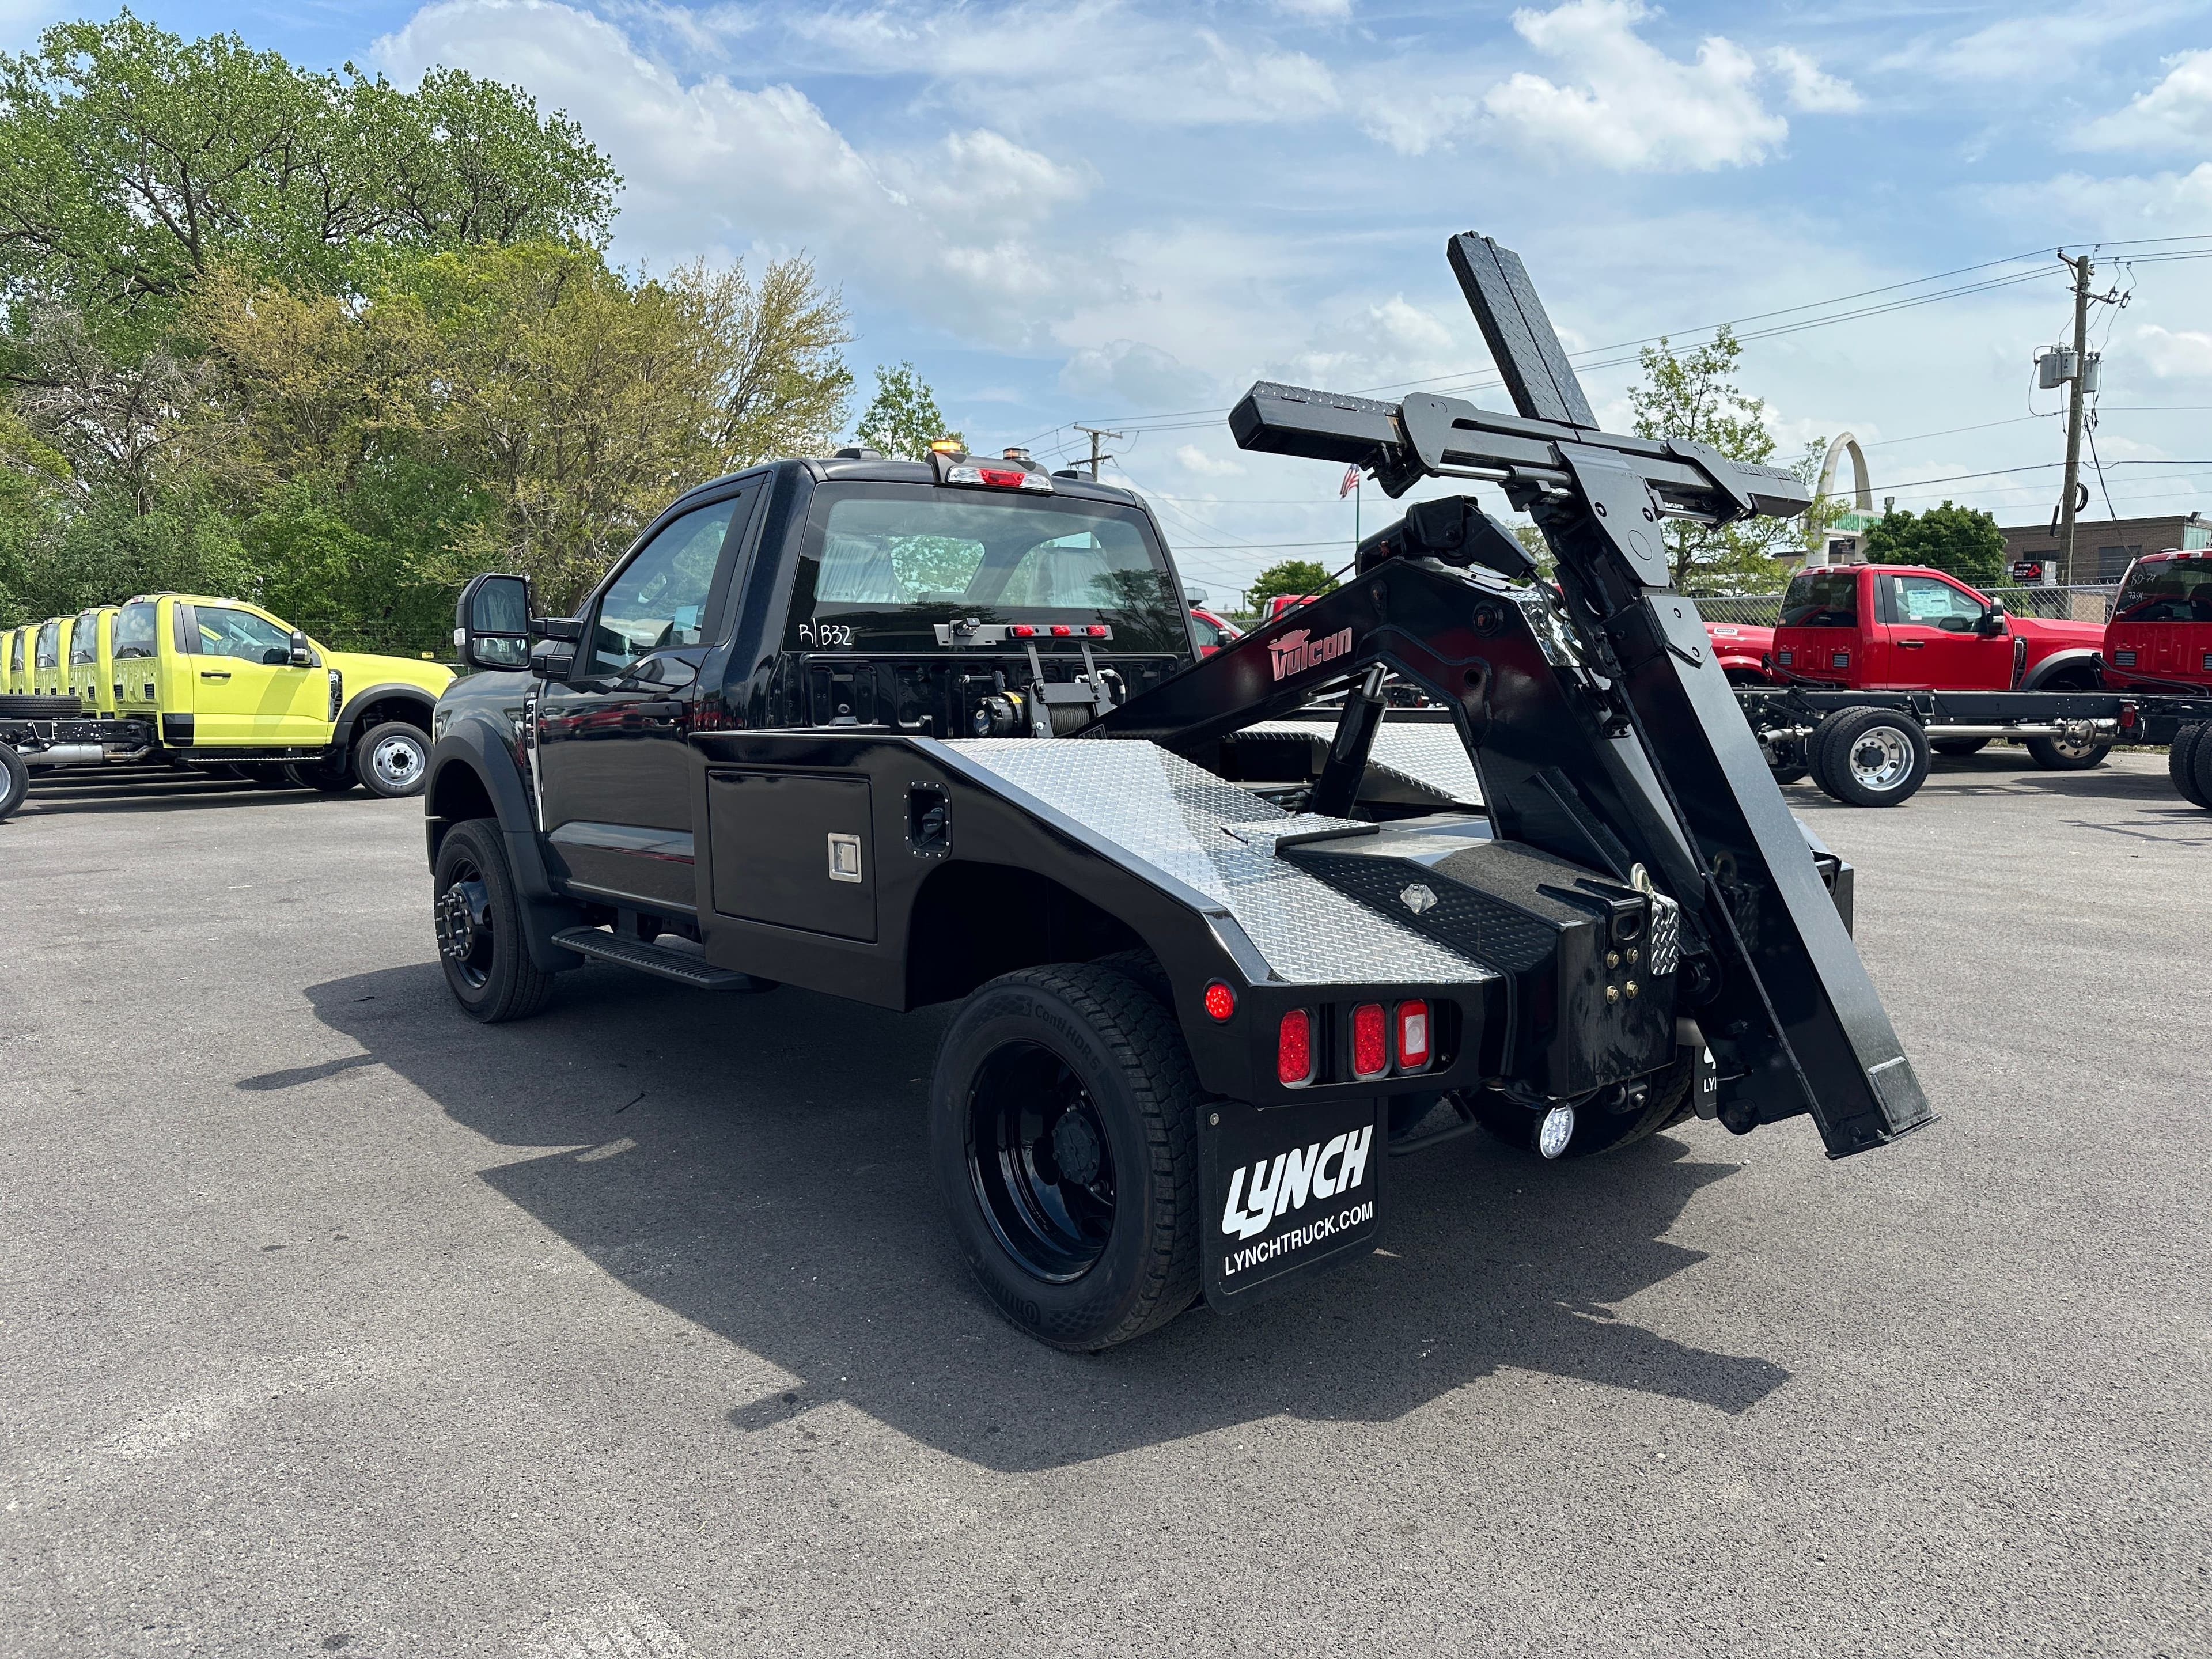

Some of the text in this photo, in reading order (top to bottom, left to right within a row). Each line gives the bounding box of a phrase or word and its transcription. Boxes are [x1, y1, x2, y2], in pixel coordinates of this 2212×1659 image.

[1268, 627, 1353, 681] Vulcan
[1221, 1124, 1374, 1241] LYNCH
[1225, 1200, 1373, 1276] LYNCHTRUCK.COM
